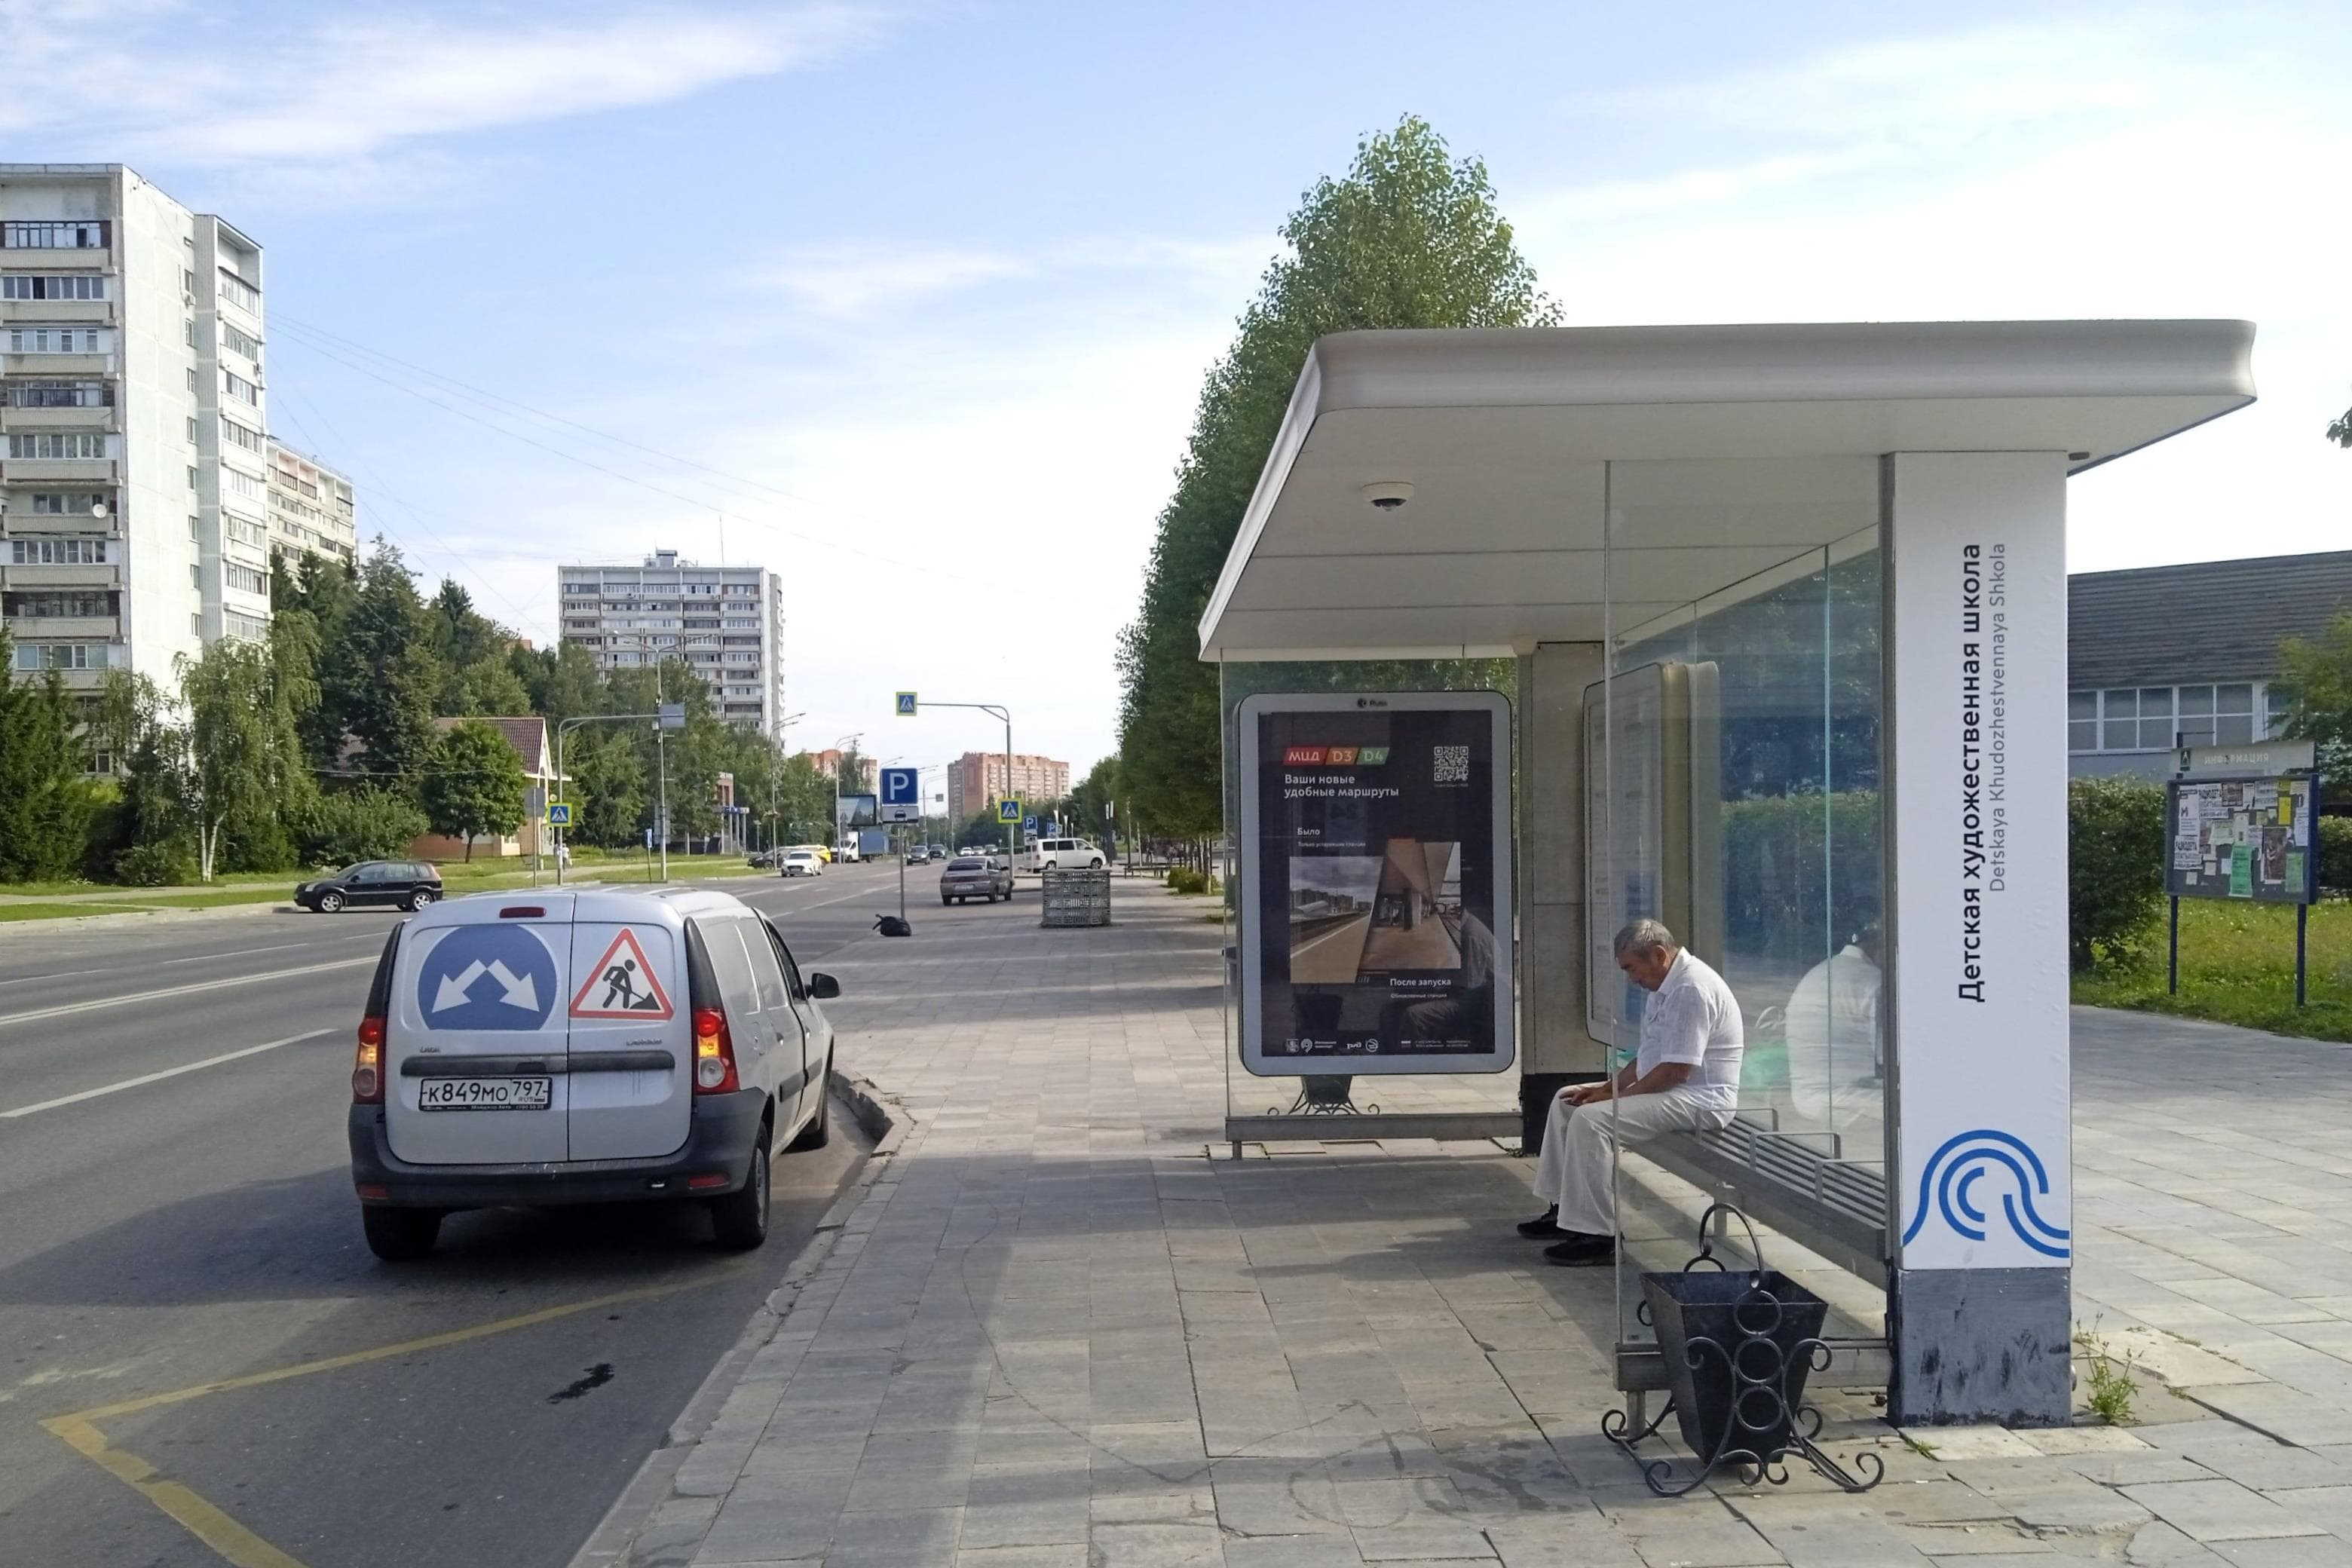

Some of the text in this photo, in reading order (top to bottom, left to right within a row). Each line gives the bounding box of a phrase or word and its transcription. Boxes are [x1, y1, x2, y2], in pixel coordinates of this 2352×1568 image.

[1989, 544, 2008, 891] Detskaya Khudozhestvennaya Shkola
[1332, 751, 1352, 762] D3
[1364, 751, 1383, 762] D4
[1285, 774, 1355, 784] Ваши новые
[1958, 544, 1986, 1003] Детская художественная школа
[890, 773, 909, 800] P
[1284, 786, 1399, 798] удобные маршруты
[1297, 827, 1320, 836] Было
[1418, 979, 1452, 988] запуска
[428, 1081, 544, 1103] К849МО 797
